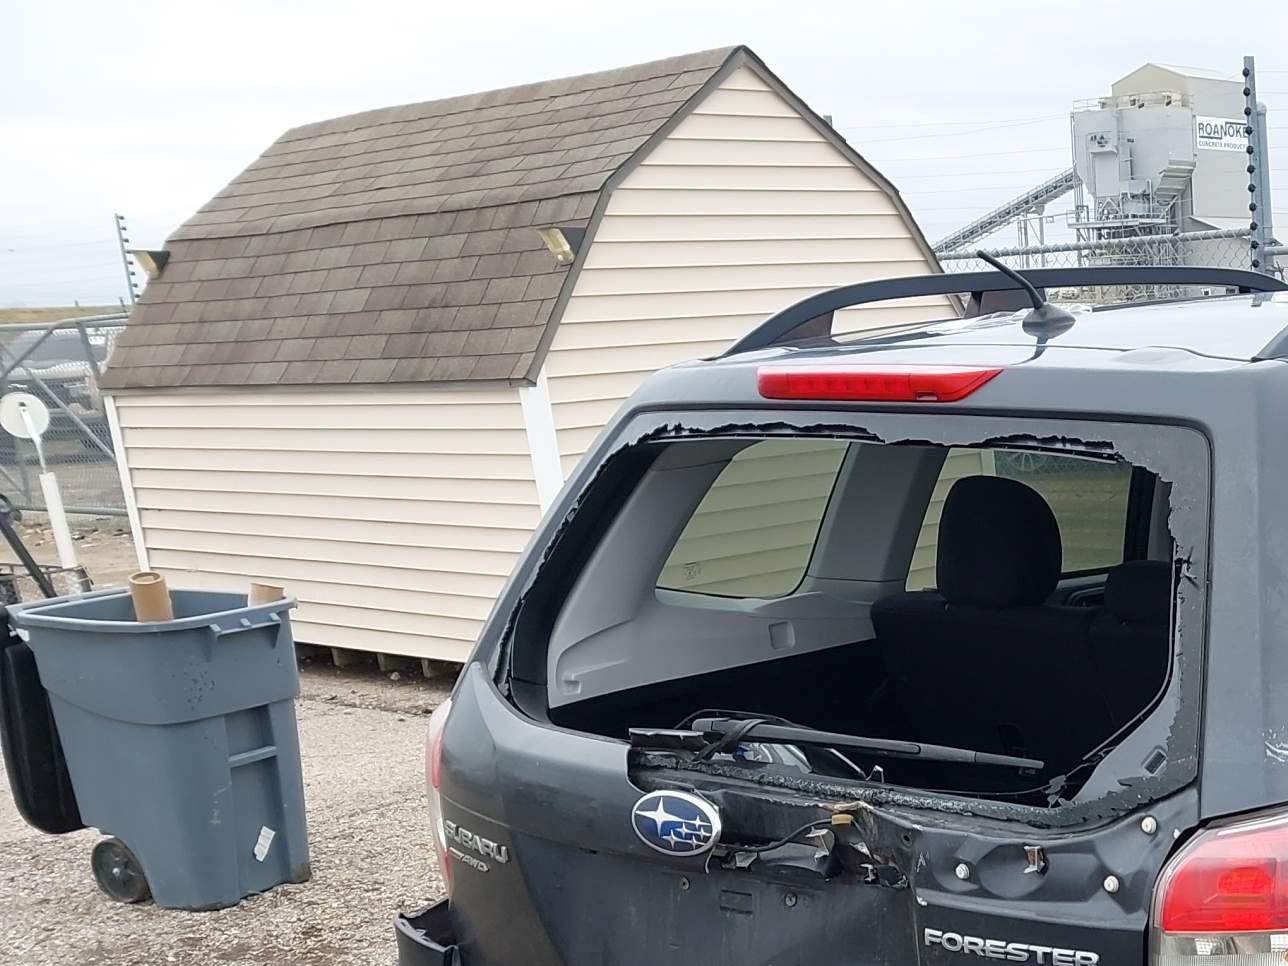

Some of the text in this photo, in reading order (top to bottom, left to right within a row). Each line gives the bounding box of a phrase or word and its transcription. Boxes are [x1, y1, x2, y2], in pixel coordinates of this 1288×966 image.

[1198, 121, 1250, 139] ROANOKE
[444, 820, 509, 864] SUBARU
[461, 854, 490, 873] AWD
